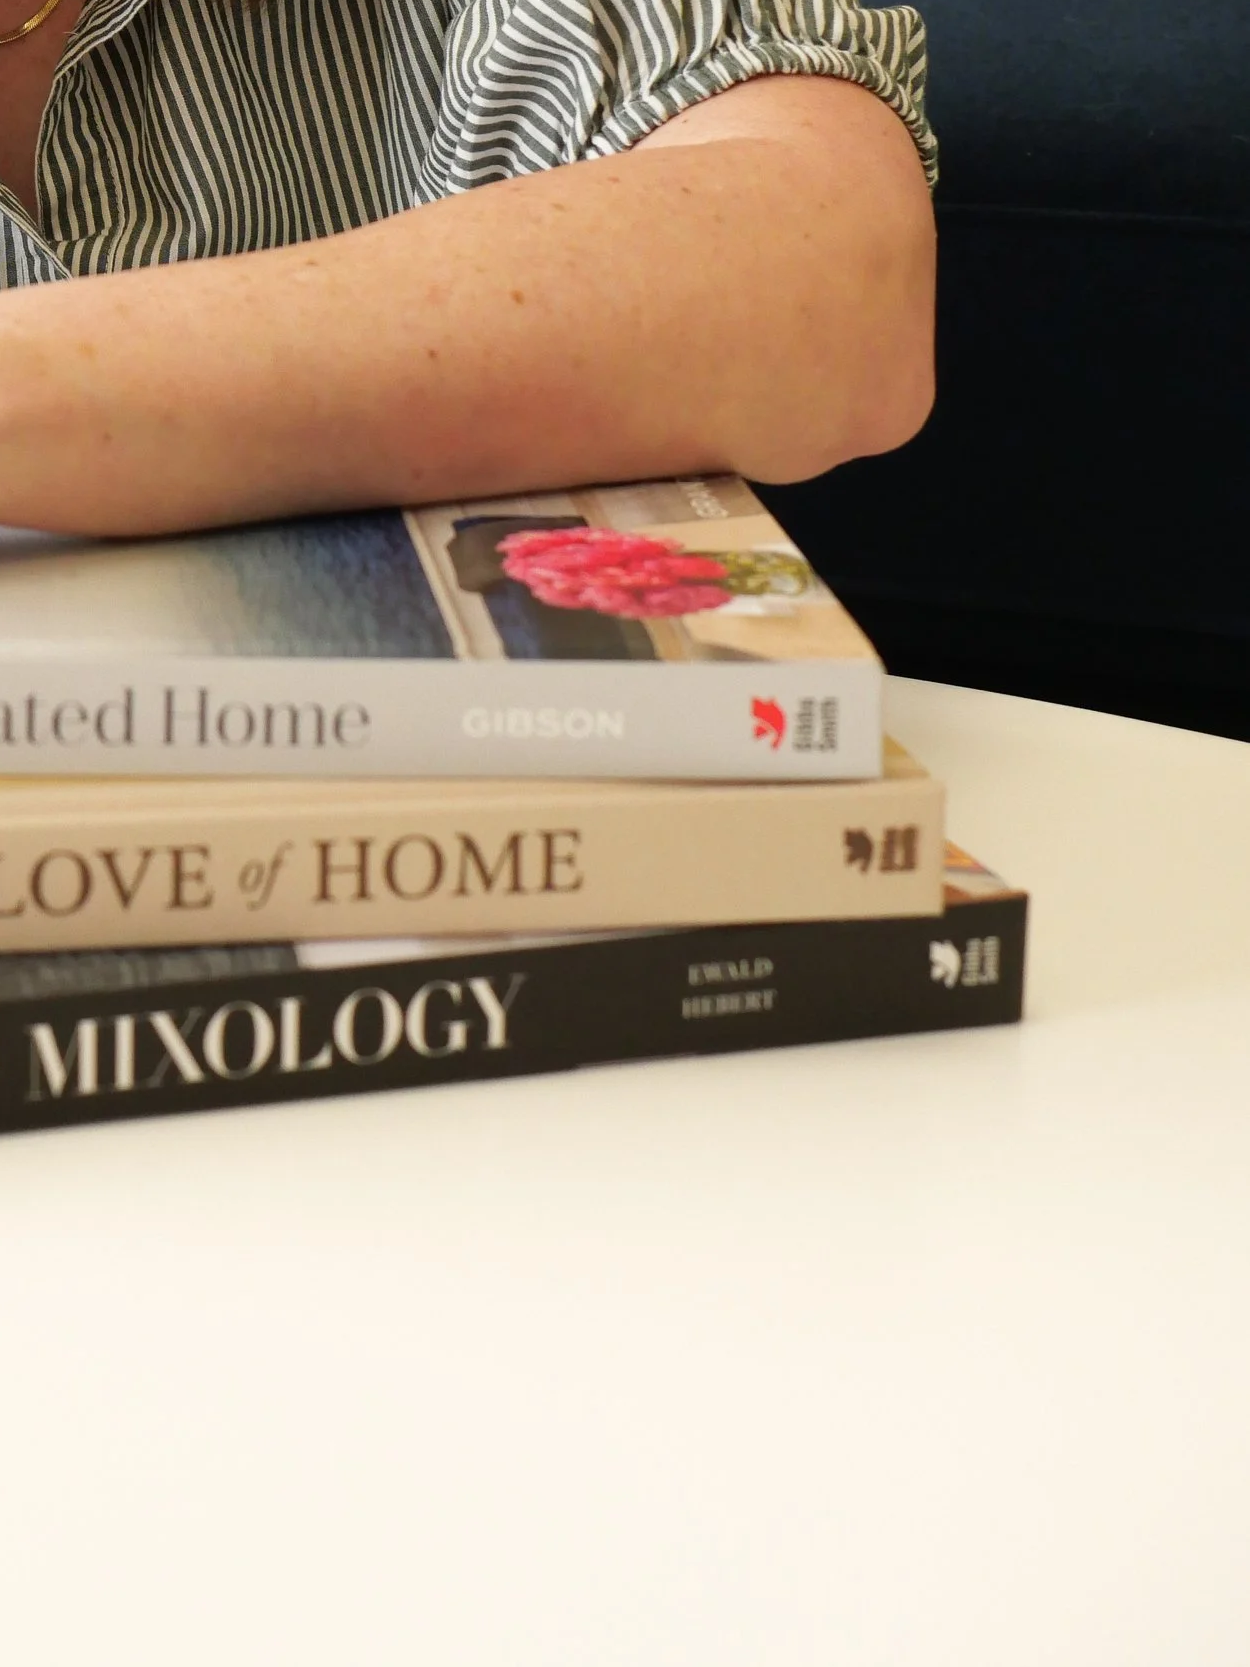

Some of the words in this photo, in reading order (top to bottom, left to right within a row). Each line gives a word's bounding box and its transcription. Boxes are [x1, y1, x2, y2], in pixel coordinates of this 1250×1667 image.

[159, 684, 371, 750] Home
[460, 705, 625, 739] GIBSON
[237, 840, 295, 912] of
[312, 828, 586, 904] HOME
[687, 957, 775, 986] EWALD
[681, 988, 778, 1021] HEBERT
[24, 972, 528, 1104] MIXOLOGY
